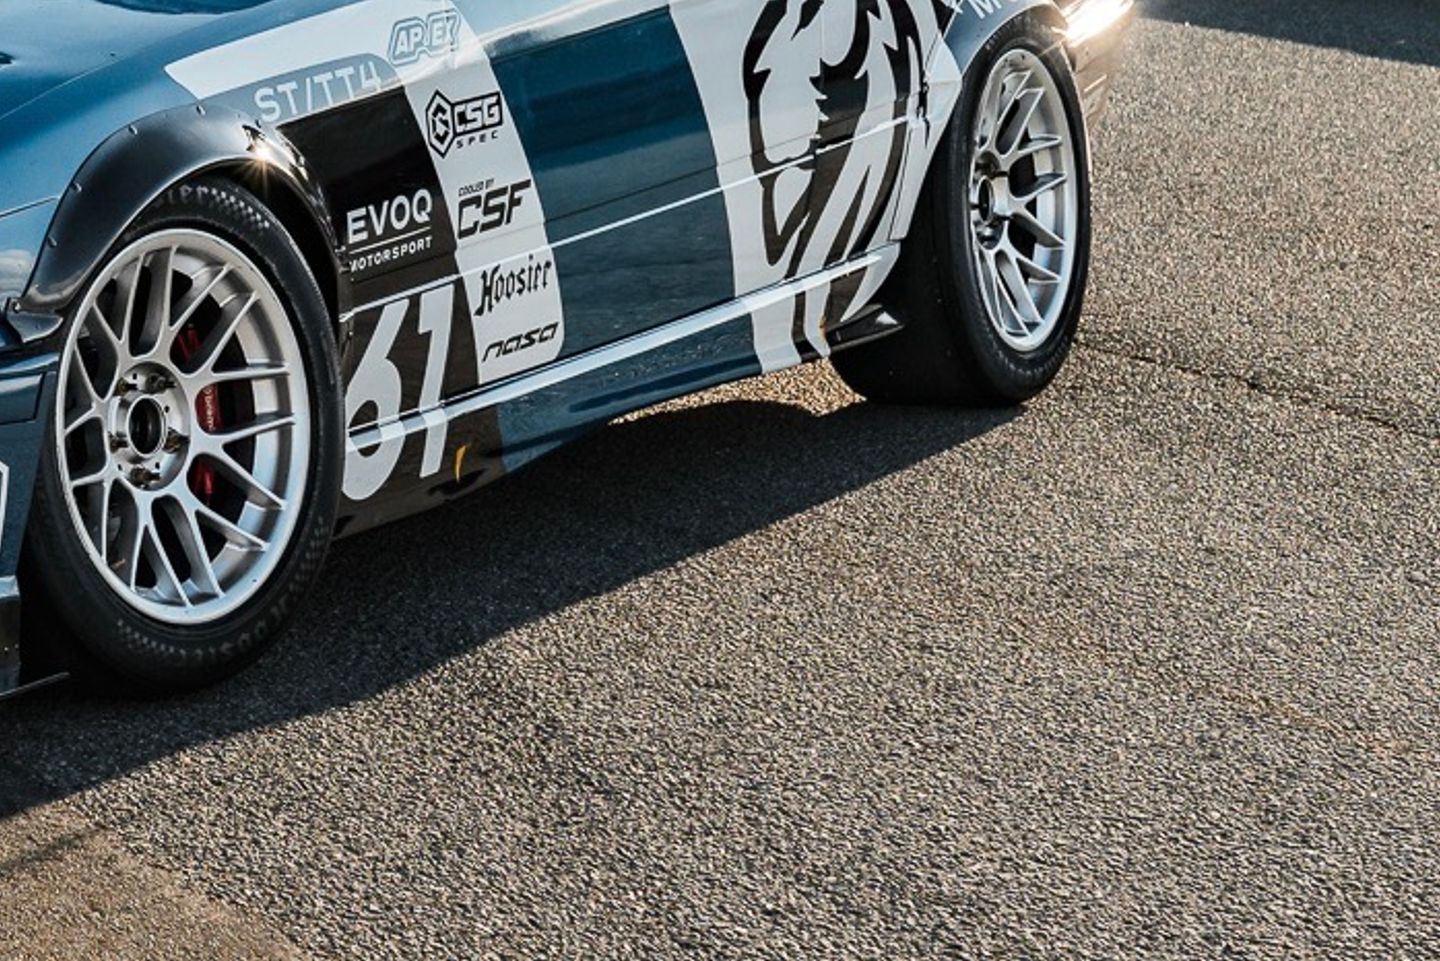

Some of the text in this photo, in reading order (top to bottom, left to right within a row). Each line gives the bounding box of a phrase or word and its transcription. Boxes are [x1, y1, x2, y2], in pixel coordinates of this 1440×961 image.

[391, 12, 459, 61] APEX
[254, 61, 383, 123] ST/TT4
[454, 95, 501, 133] CSG
[456, 129, 498, 149] SPEC
[347, 189, 432, 244] EVOQ
[459, 179, 532, 239] CSF
[349, 236, 432, 272] MOTORSPORT
[473, 253, 552, 316] Hoosier
[482, 321, 559, 362] nasa
[342, 284, 455, 500] 61
